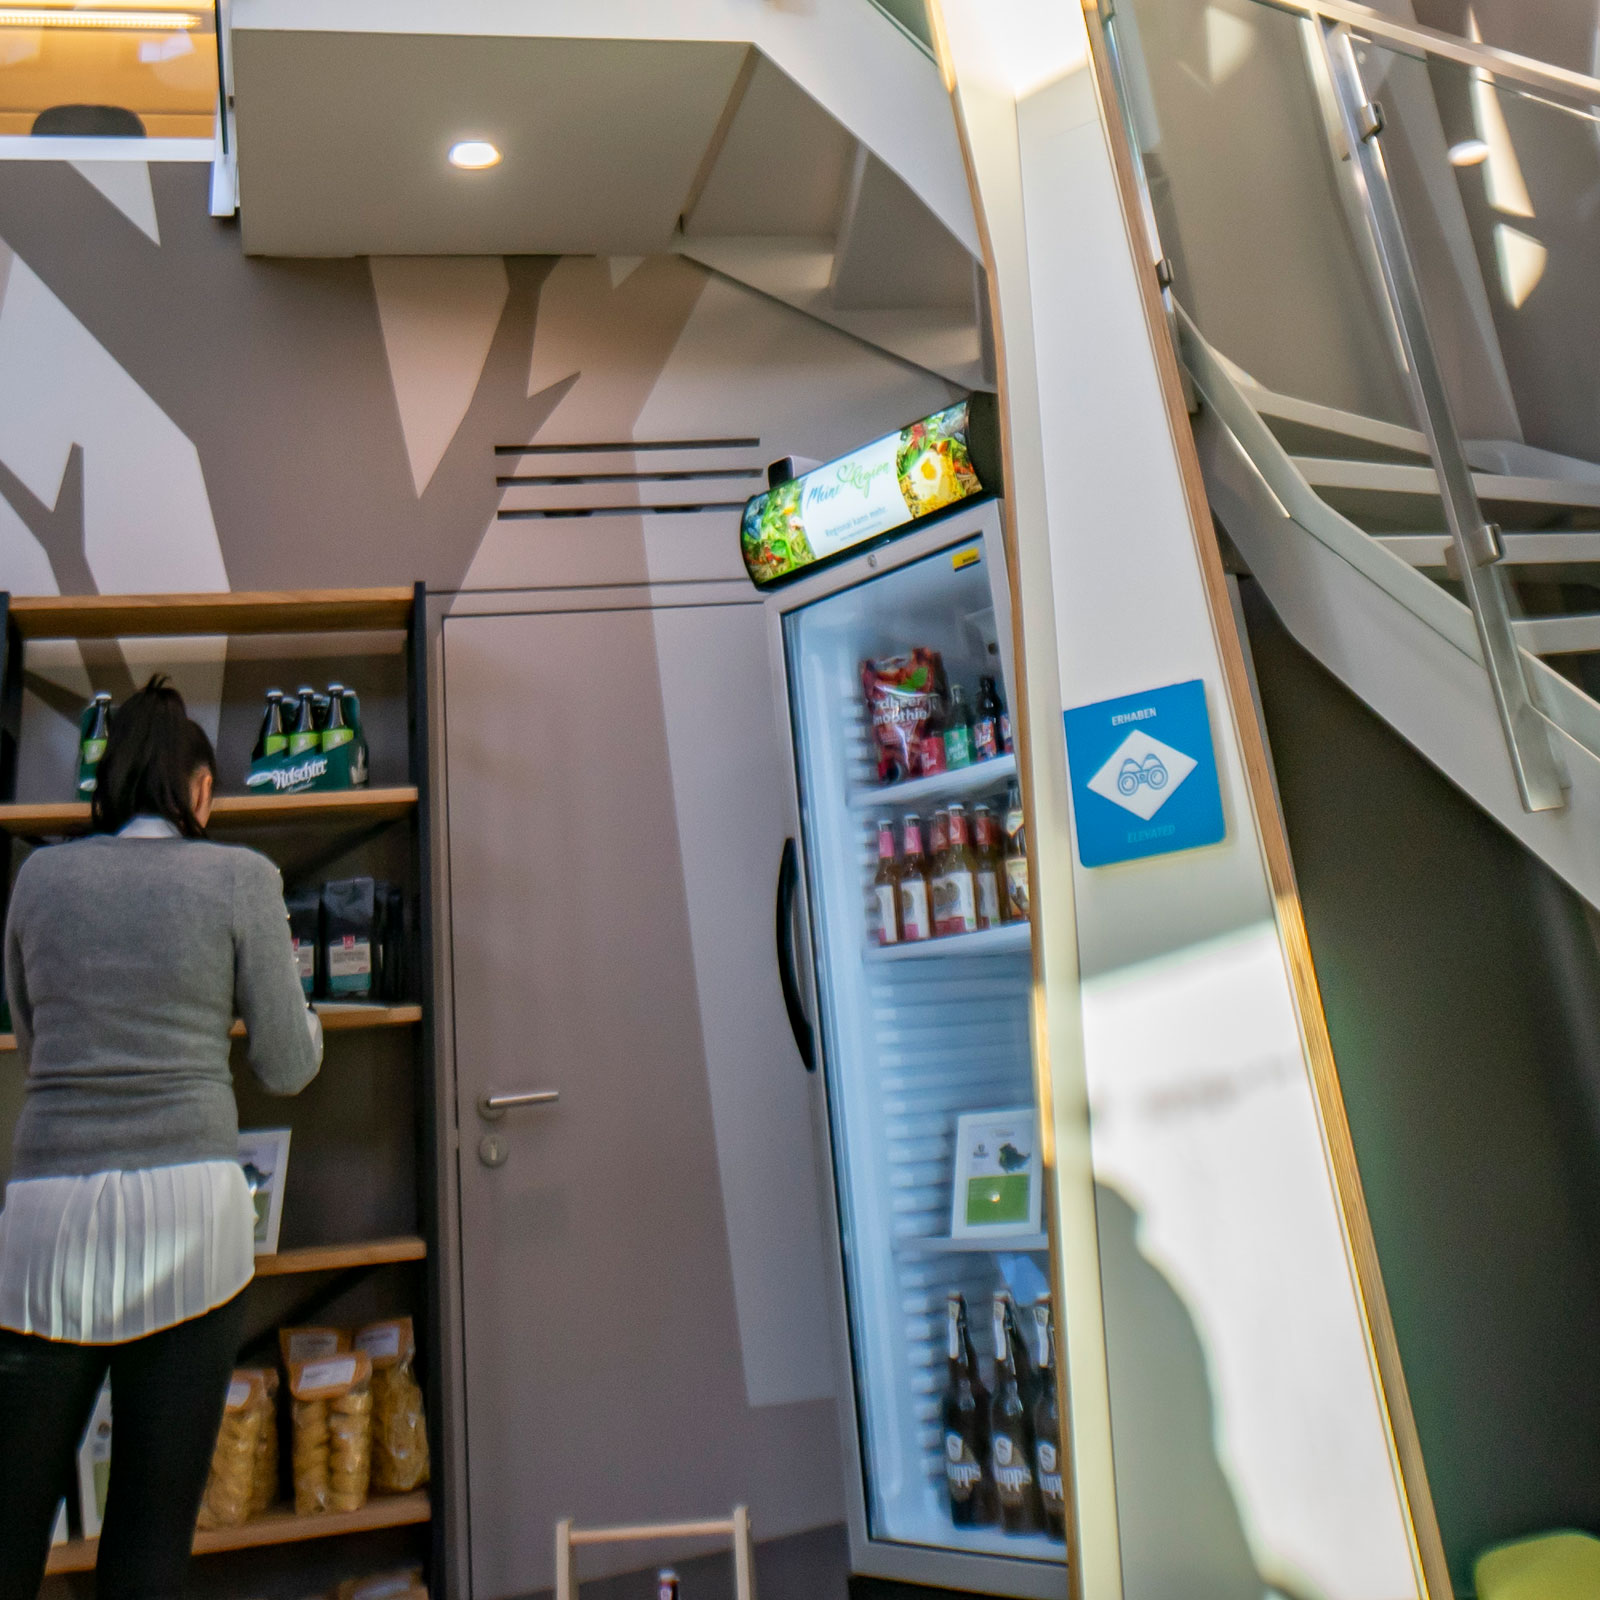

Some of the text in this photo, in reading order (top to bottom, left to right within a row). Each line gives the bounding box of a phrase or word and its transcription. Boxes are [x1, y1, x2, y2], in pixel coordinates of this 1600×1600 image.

[873, 708, 929, 727] moothie
[1111, 707, 1157, 727] ERHABEN
[1127, 824, 1176, 844] ELEVATED
